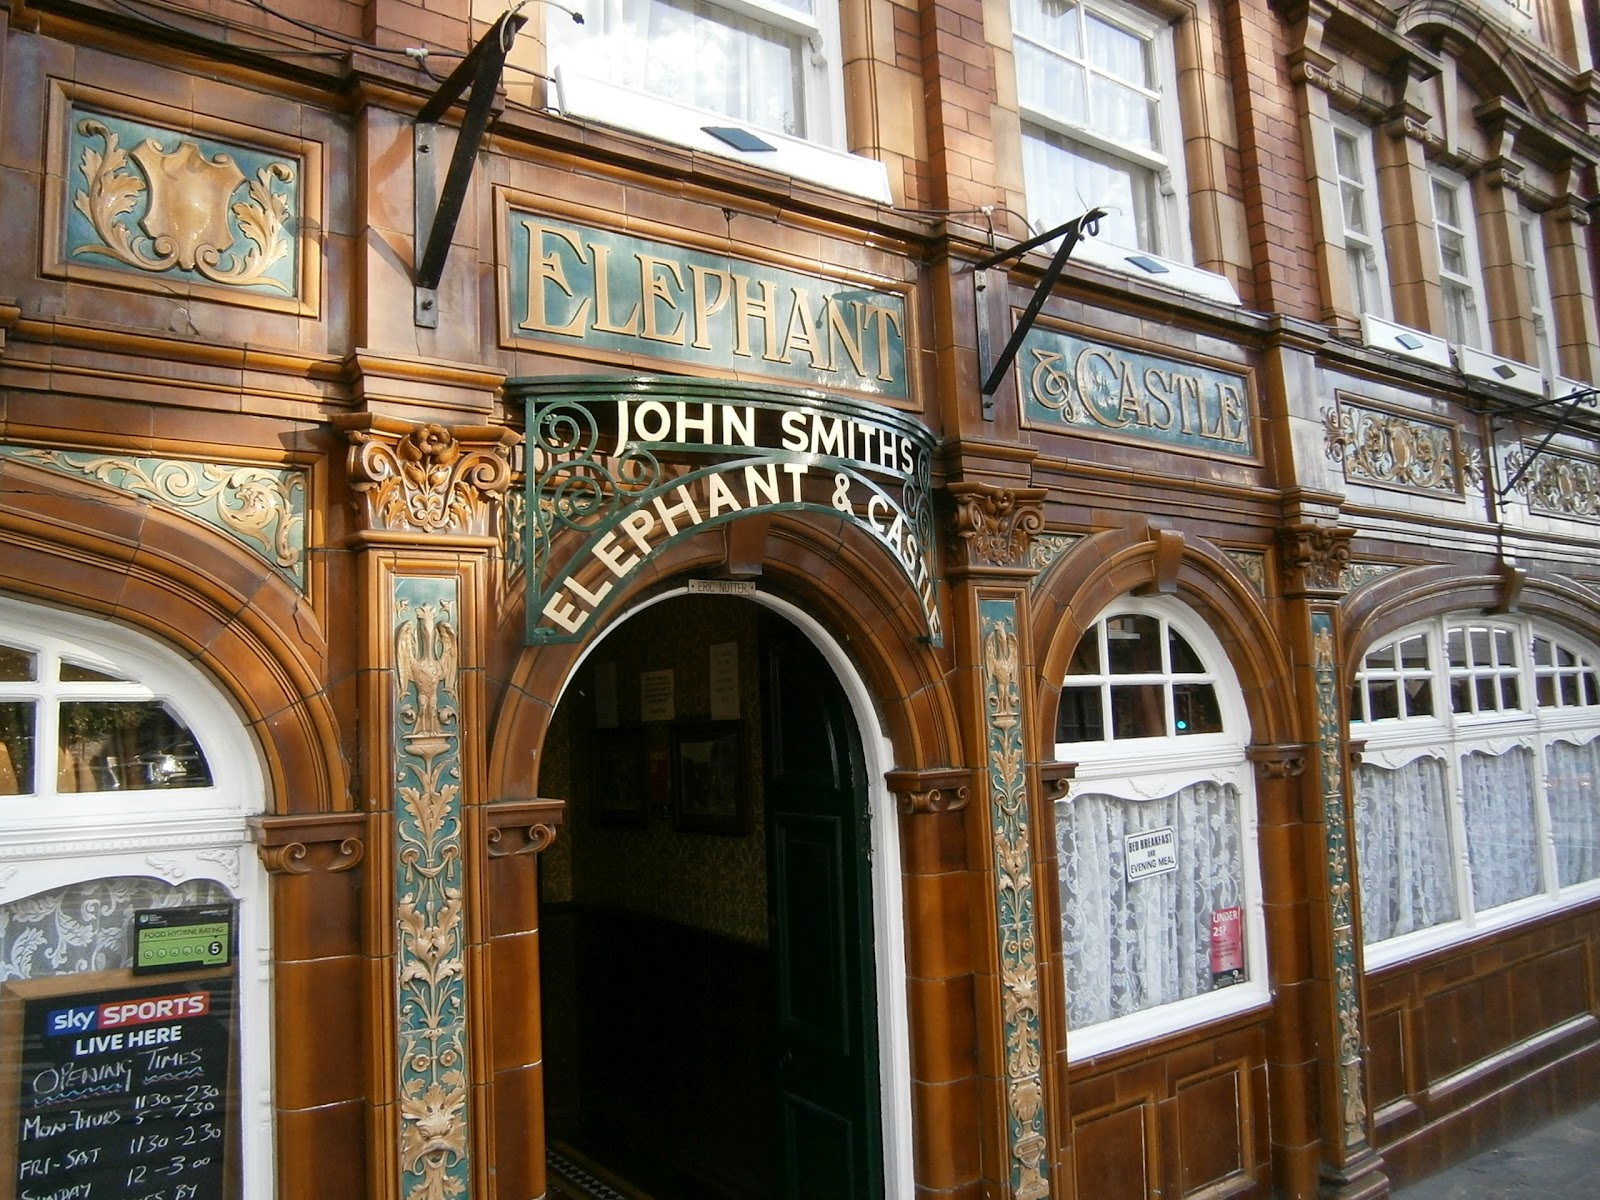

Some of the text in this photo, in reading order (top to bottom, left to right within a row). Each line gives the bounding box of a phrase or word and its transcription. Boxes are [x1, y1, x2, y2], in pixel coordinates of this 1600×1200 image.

[519, 220, 903, 382] ELEPHANT
[1030, 347, 1246, 443] & CASTLE
[612, 400, 914, 475] JOHN SMITHS
[542, 464, 941, 640] ELEPHANT & CASTLE
[698, 581, 748, 593] ERIC NUTTER
[1129, 833, 1172, 852] BED BREAKFAST
[1131, 855, 1175, 874] EVENING MEAL
[144, 926, 224, 939] FOOD HYGIENE RATING
[1212, 910, 1238, 924] UNDER
[211, 942, 220, 954] 5
[54, 995, 204, 1031] sky SPORTS
[75, 1025, 183, 1056] LIVE HERE
[33, 1045, 203, 1094] OPENING TIMES
